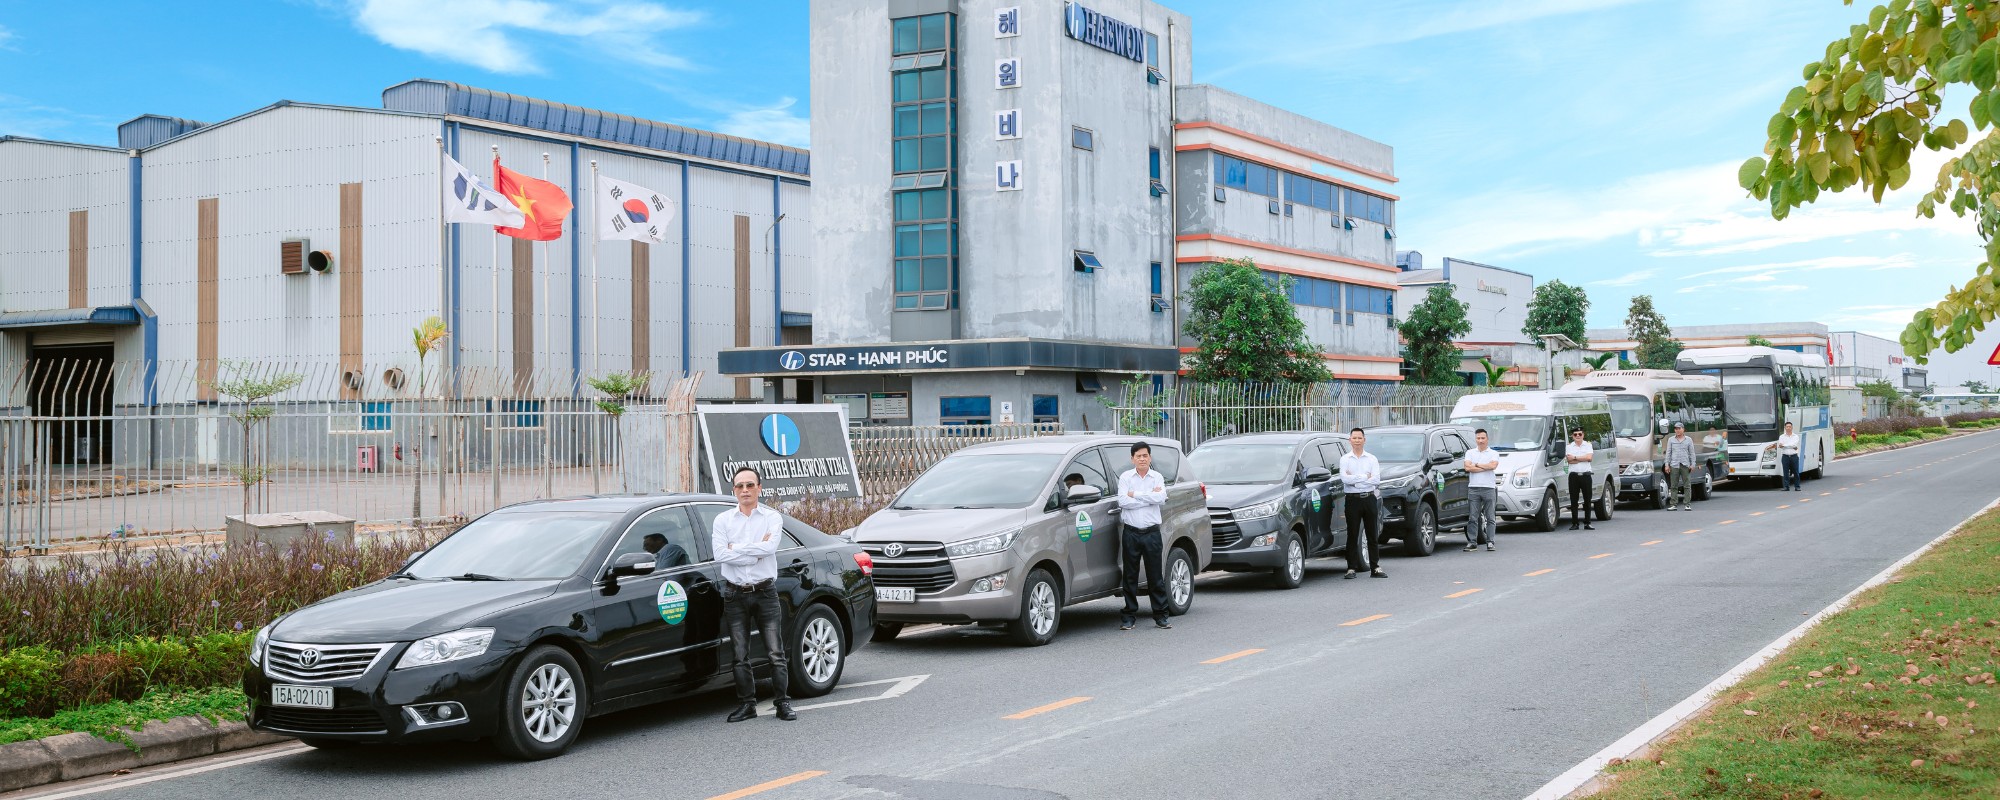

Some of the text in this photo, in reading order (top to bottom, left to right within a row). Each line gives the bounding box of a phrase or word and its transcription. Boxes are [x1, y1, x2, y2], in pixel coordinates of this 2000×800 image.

[1083, 7, 1144, 63] HAEWON
[808, 353, 847, 367] STAR
[858, 351, 901, 367] HẠNH
[905, 347, 948, 364] PHÚC
[761, 459, 790, 480] TNHH
[788, 458, 828, 478] HAEWON
[826, 457, 849, 476] VINA
[275, 687, 329, 706] 15A-021.01
